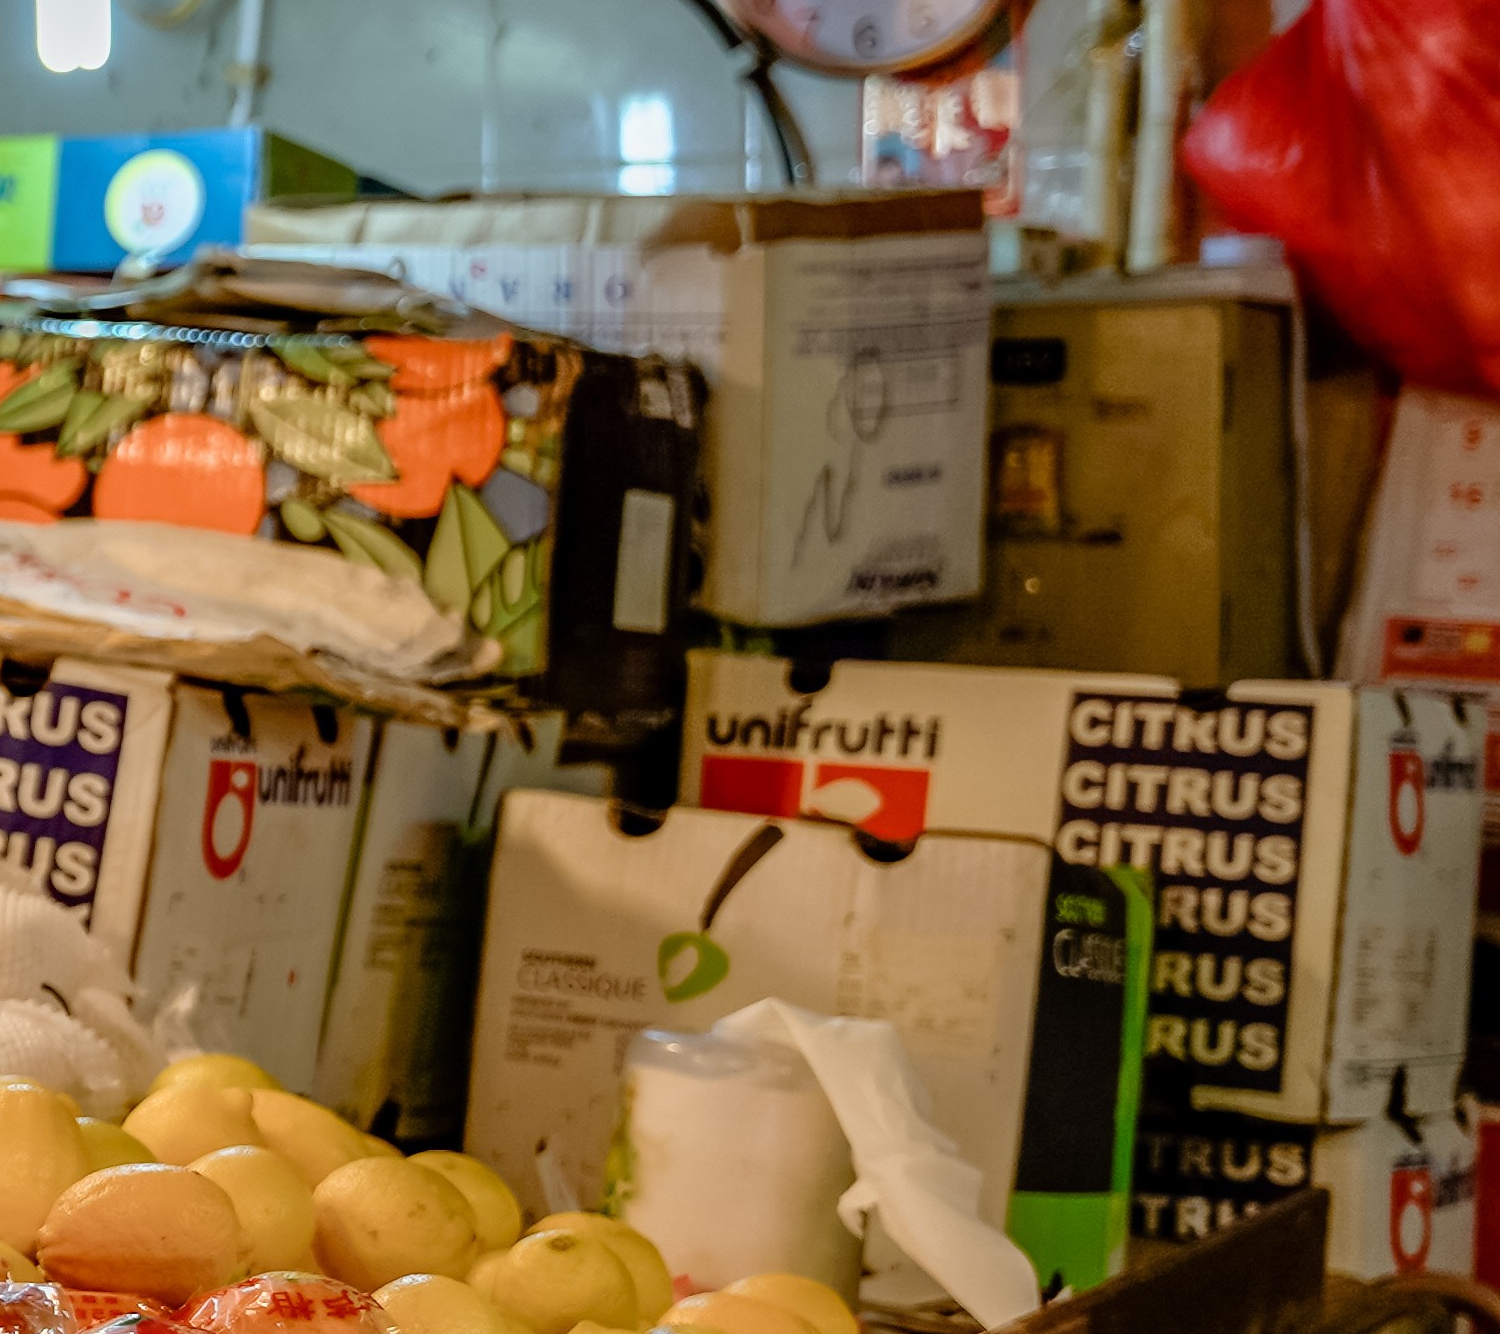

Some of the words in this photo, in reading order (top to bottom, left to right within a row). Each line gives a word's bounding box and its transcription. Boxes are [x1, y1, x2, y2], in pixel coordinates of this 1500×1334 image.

[705, 696, 942, 766] unifrutti
[1068, 698, 1308, 762] CITRUS
[1061, 759, 1304, 825] CITRUS
[1054, 818, 1299, 885] CITRUS
[1158, 884, 1293, 942] RUS
[1152, 950, 1286, 1007] RUS
[1145, 1013, 1280, 1071] RUS
[1142, 1134, 1307, 1187] TRUS
